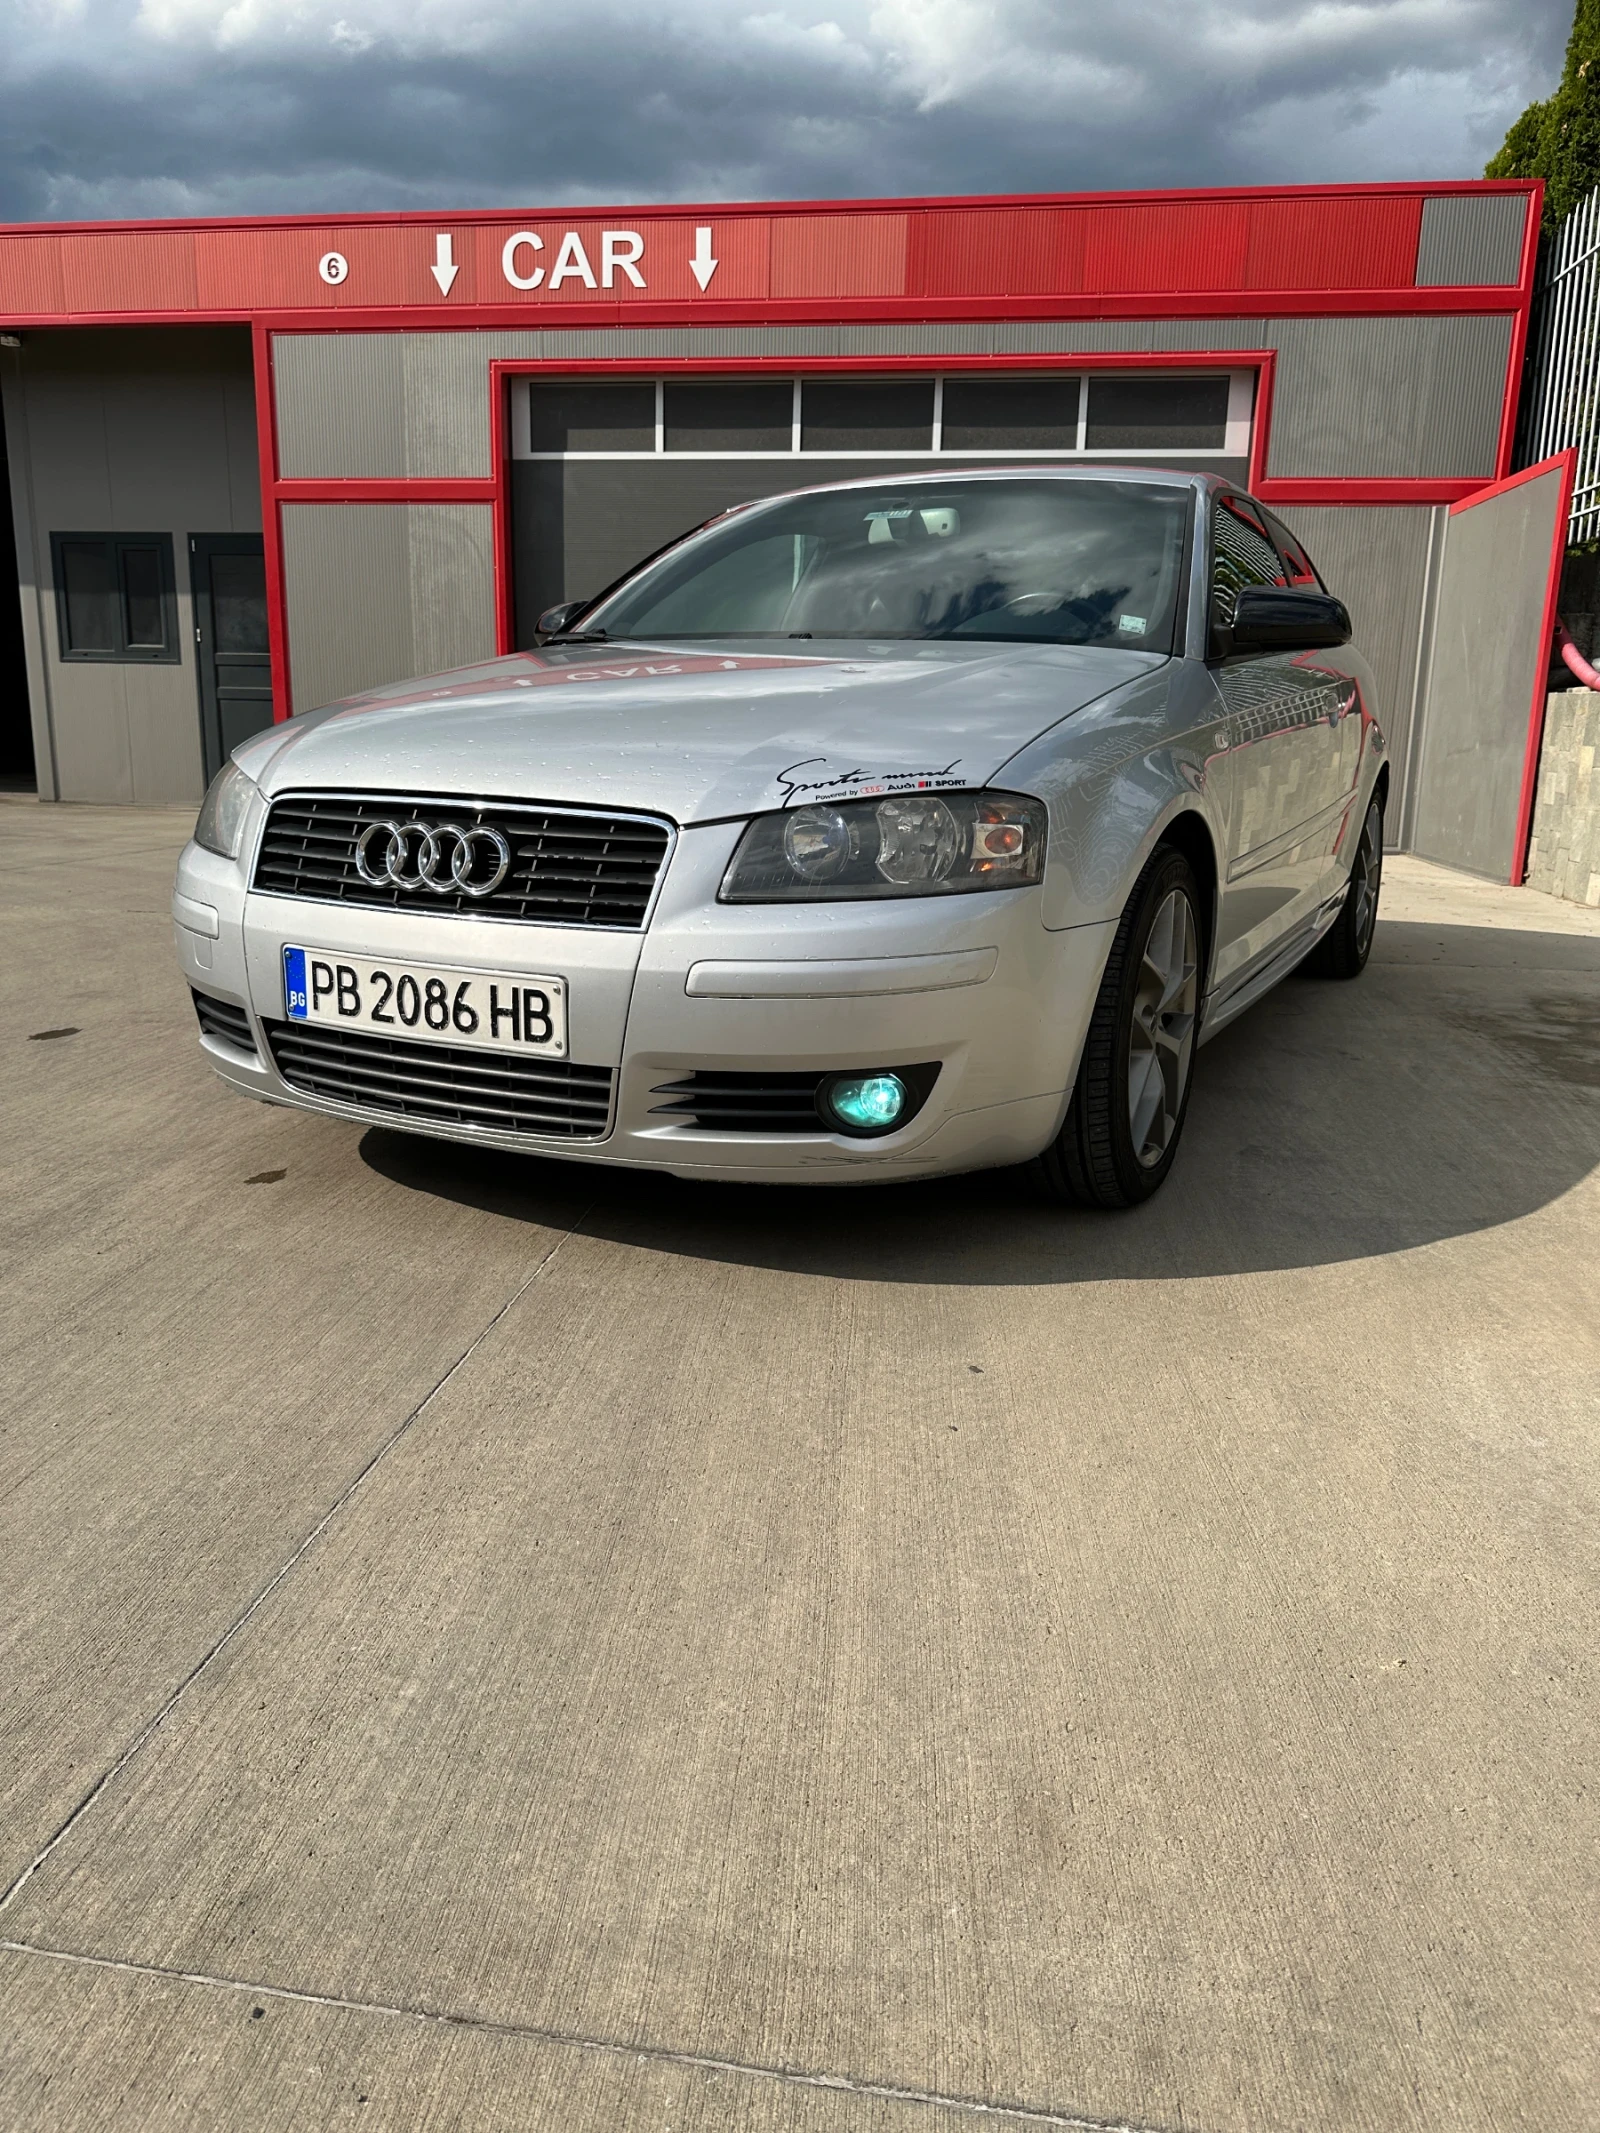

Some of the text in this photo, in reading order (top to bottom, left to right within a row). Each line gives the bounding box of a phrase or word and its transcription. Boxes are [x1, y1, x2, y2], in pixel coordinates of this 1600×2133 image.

[502, 231, 647, 290] CAR
[815, 790, 847, 801] Powered
[887, 782, 915, 791] Audi
[935, 779, 966, 787] SPORT
[290, 990, 306, 1006] BG
[311, 960, 554, 1044] PB 2086 HB
